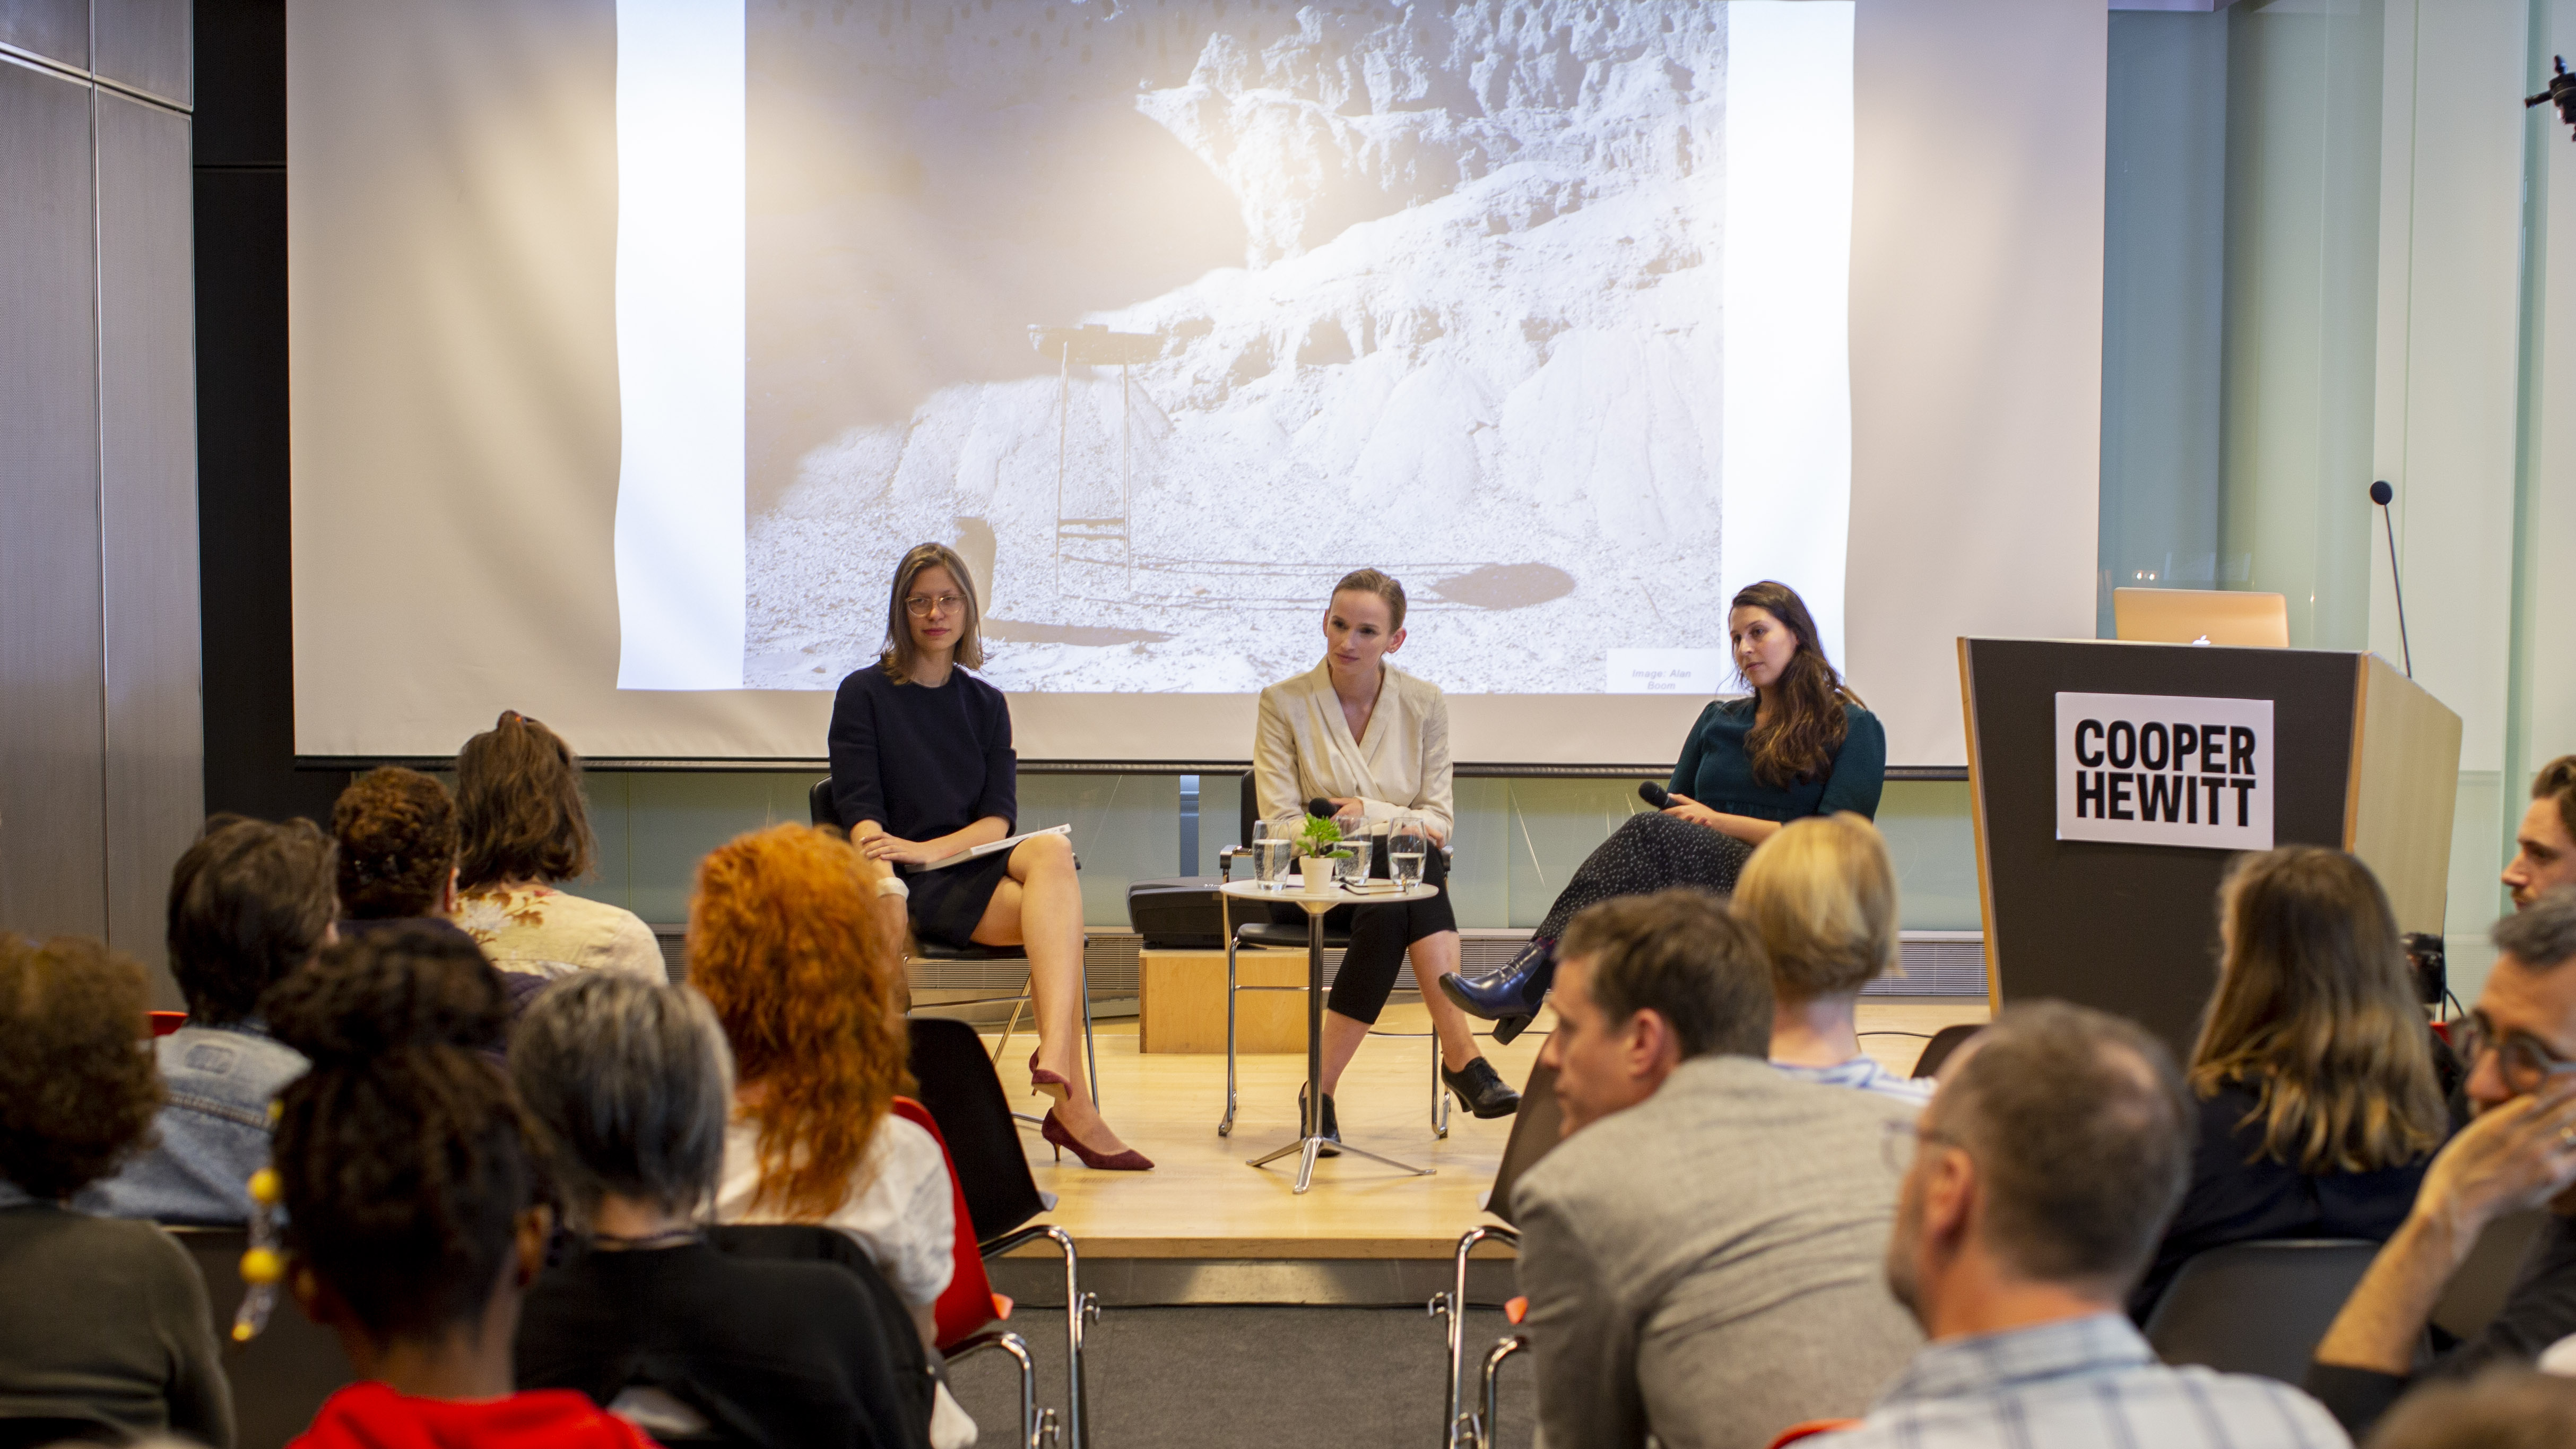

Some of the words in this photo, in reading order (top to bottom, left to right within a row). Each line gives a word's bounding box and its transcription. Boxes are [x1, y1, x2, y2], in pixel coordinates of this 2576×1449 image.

[1633, 669, 1666, 679] Image:
[1670, 669, 1692, 678] Alan
[2075, 719, 2256, 775] COOPER
[2076, 770, 2256, 827] HEWITT
